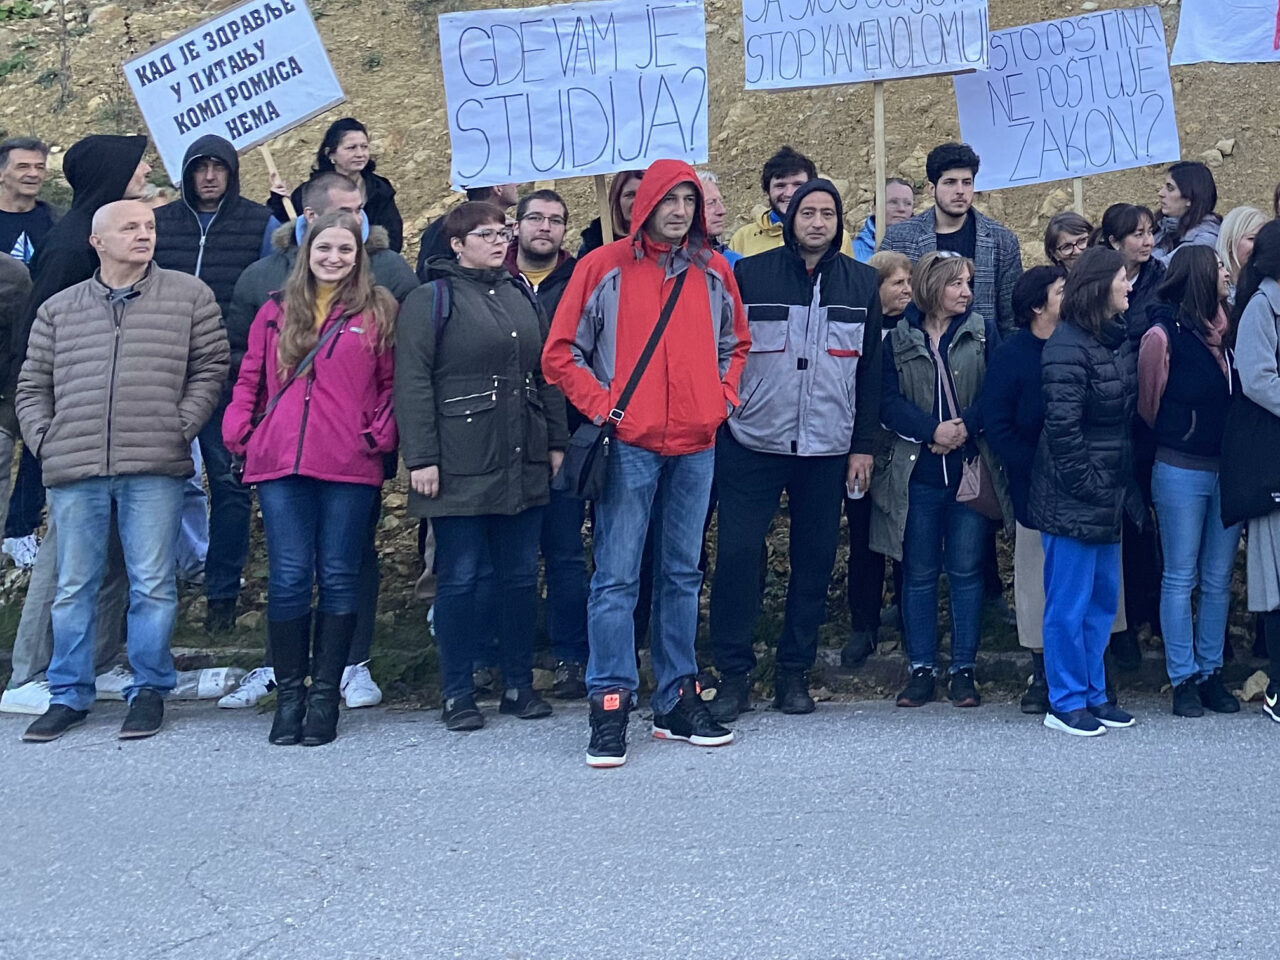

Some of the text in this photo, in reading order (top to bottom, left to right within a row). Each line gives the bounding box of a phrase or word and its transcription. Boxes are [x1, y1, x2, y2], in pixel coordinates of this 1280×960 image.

[135, 52, 176, 87] КАД
[177, 40, 201, 66] ЈЕ
[169, 39, 266, 103] У ПИТАЊУ
[458, 3, 680, 87] GDE VAM JE
[746, 28, 816, 83] STOP
[173, 56, 303, 136] КОМПРОМИСА
[224, 100, 281, 141] НЕМА
[455, 66, 706, 179] STUDIJA?
[987, 72, 1030, 127] NE
[1008, 93, 1165, 182] ZAKON?
